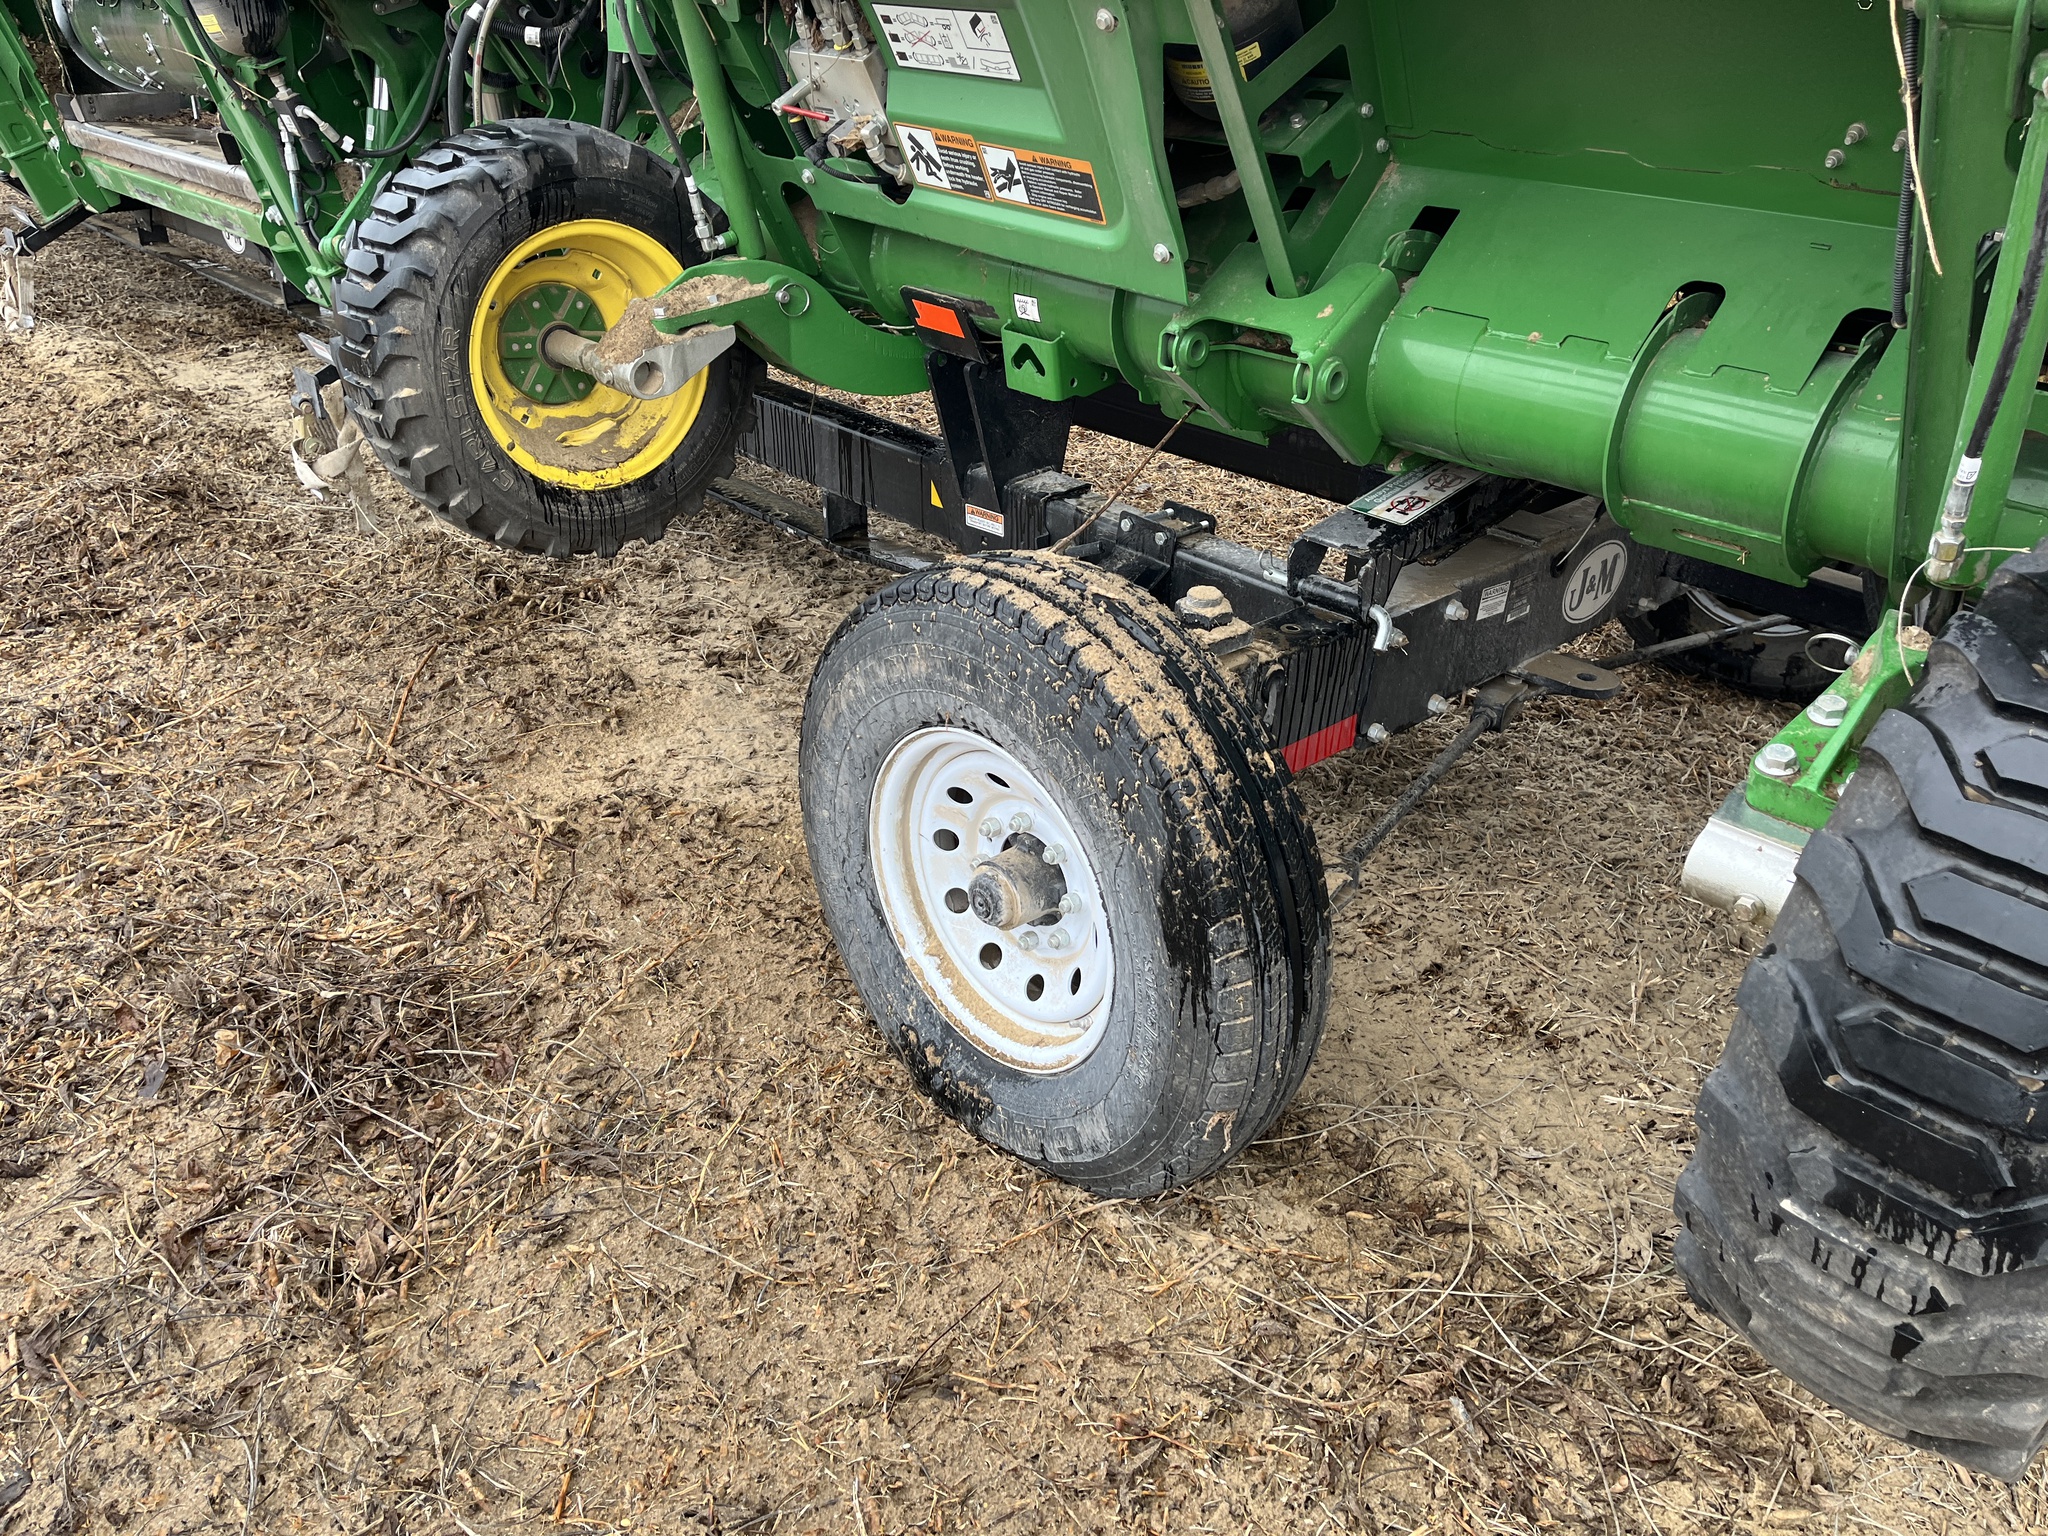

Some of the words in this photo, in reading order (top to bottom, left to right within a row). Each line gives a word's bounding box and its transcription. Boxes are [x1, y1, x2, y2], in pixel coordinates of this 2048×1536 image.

[940, 134, 973, 147] WARNING
[1039, 156, 1072, 169] WARNING
[1365, 486, 1389, 502] Always
[1569, 553, 1621, 612] J&M
